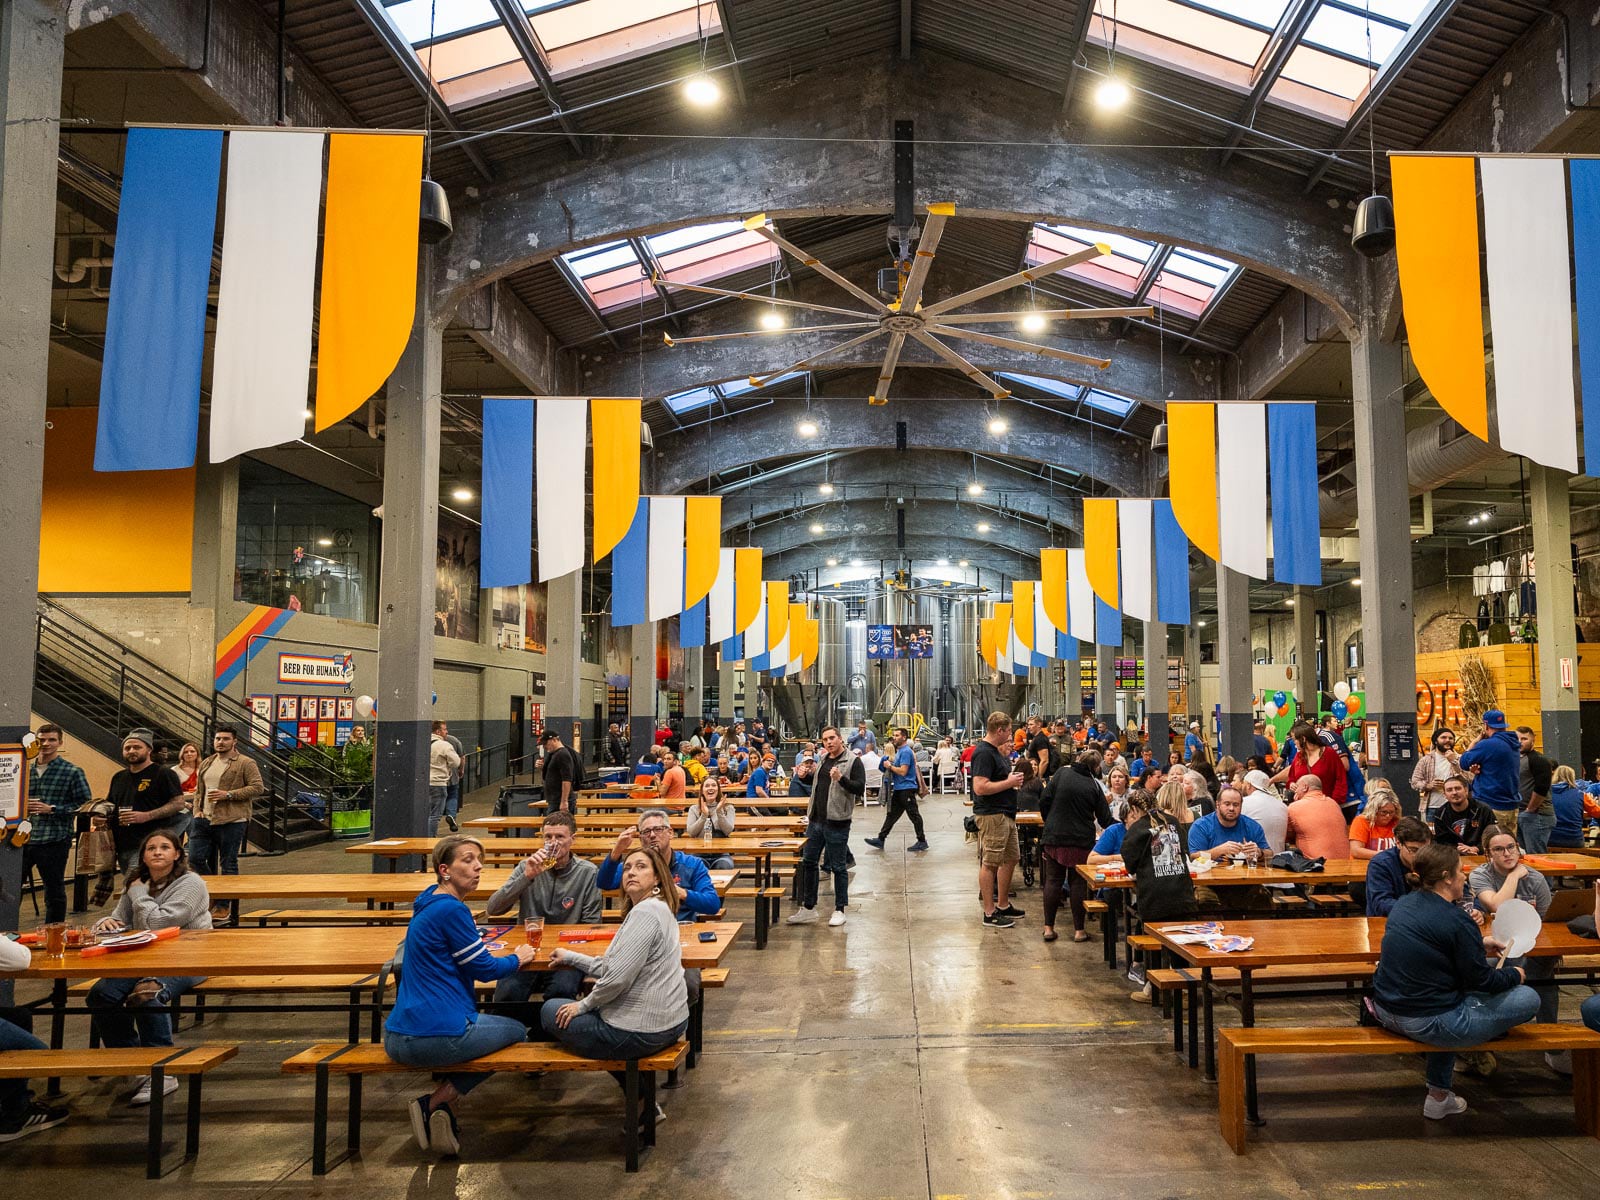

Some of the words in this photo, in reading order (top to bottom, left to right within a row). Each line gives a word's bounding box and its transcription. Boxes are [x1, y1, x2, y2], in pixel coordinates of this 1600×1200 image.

[283, 662, 300, 674] BEER
[302, 664, 315, 675] FOR
[316, 665, 340, 677] HUMANS
